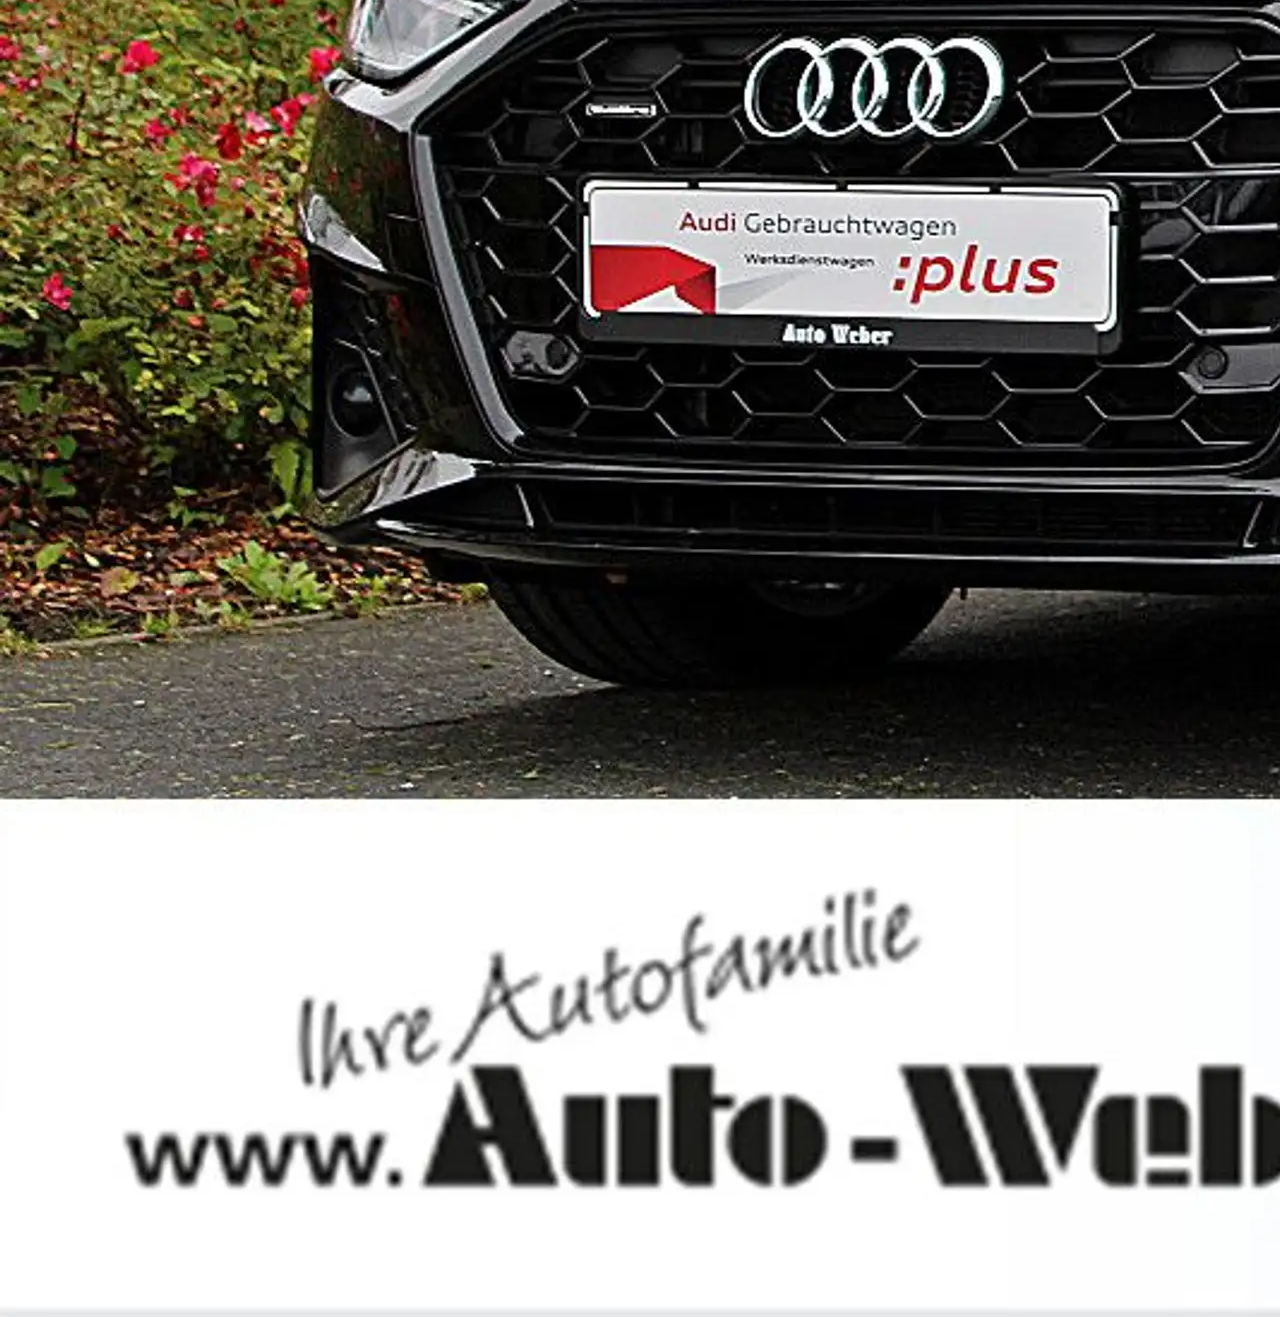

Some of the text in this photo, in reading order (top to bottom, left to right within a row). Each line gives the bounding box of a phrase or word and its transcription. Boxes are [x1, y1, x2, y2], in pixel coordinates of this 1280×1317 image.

[679, 211, 958, 241] Audi Gebrauchtwagen
[744, 252, 875, 270] Werksdienstwagen
[892, 244, 1059, 304] :plus
[782, 323, 894, 347] Auto Weber
